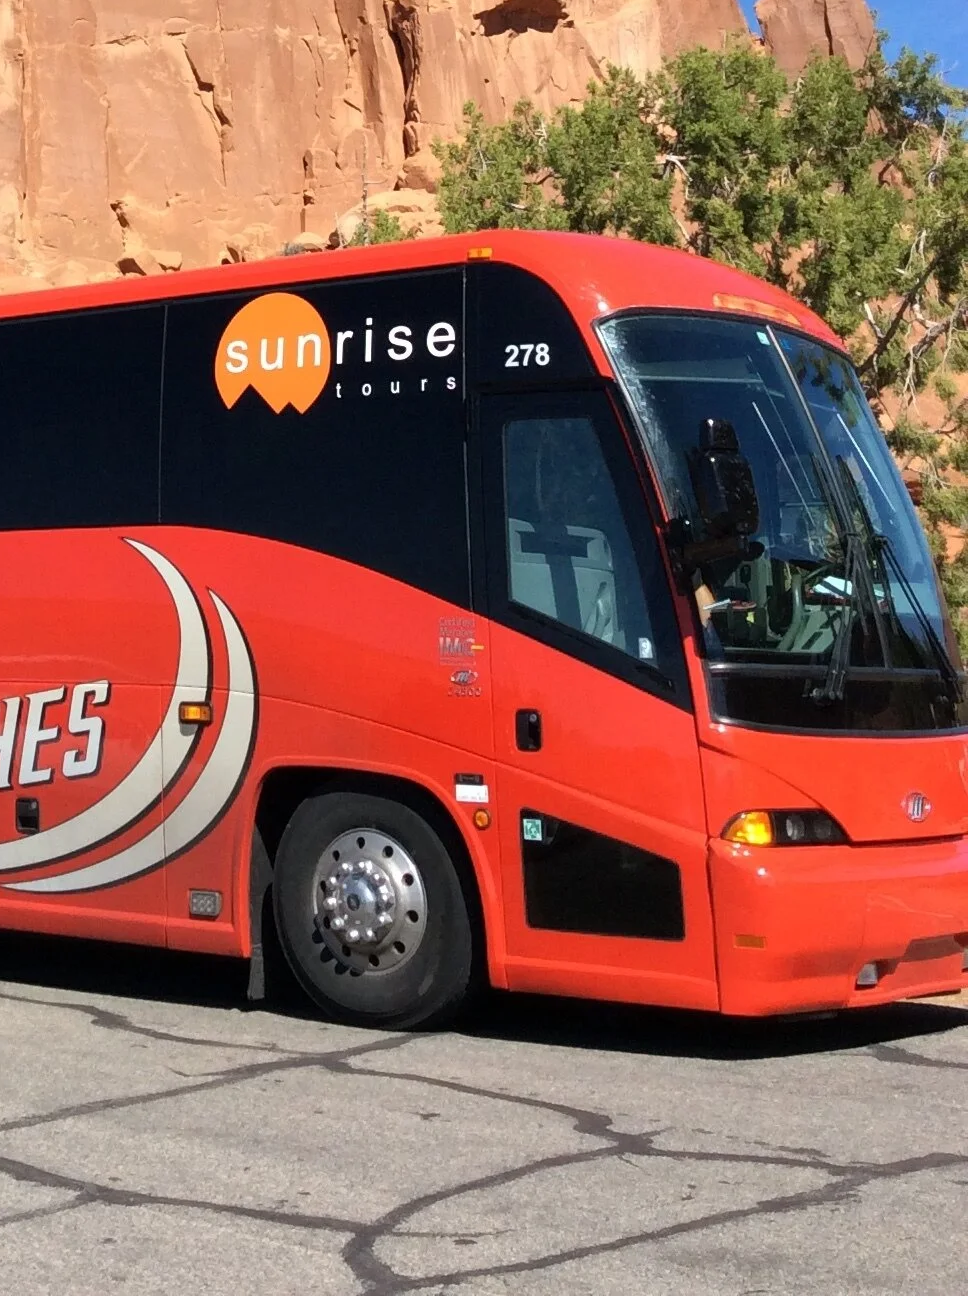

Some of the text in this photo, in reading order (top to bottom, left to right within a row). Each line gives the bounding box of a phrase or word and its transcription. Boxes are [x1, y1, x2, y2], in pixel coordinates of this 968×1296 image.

[225, 317, 457, 374] sunrise
[503, 342, 550, 368] 278
[335, 375, 457, 399] tours
